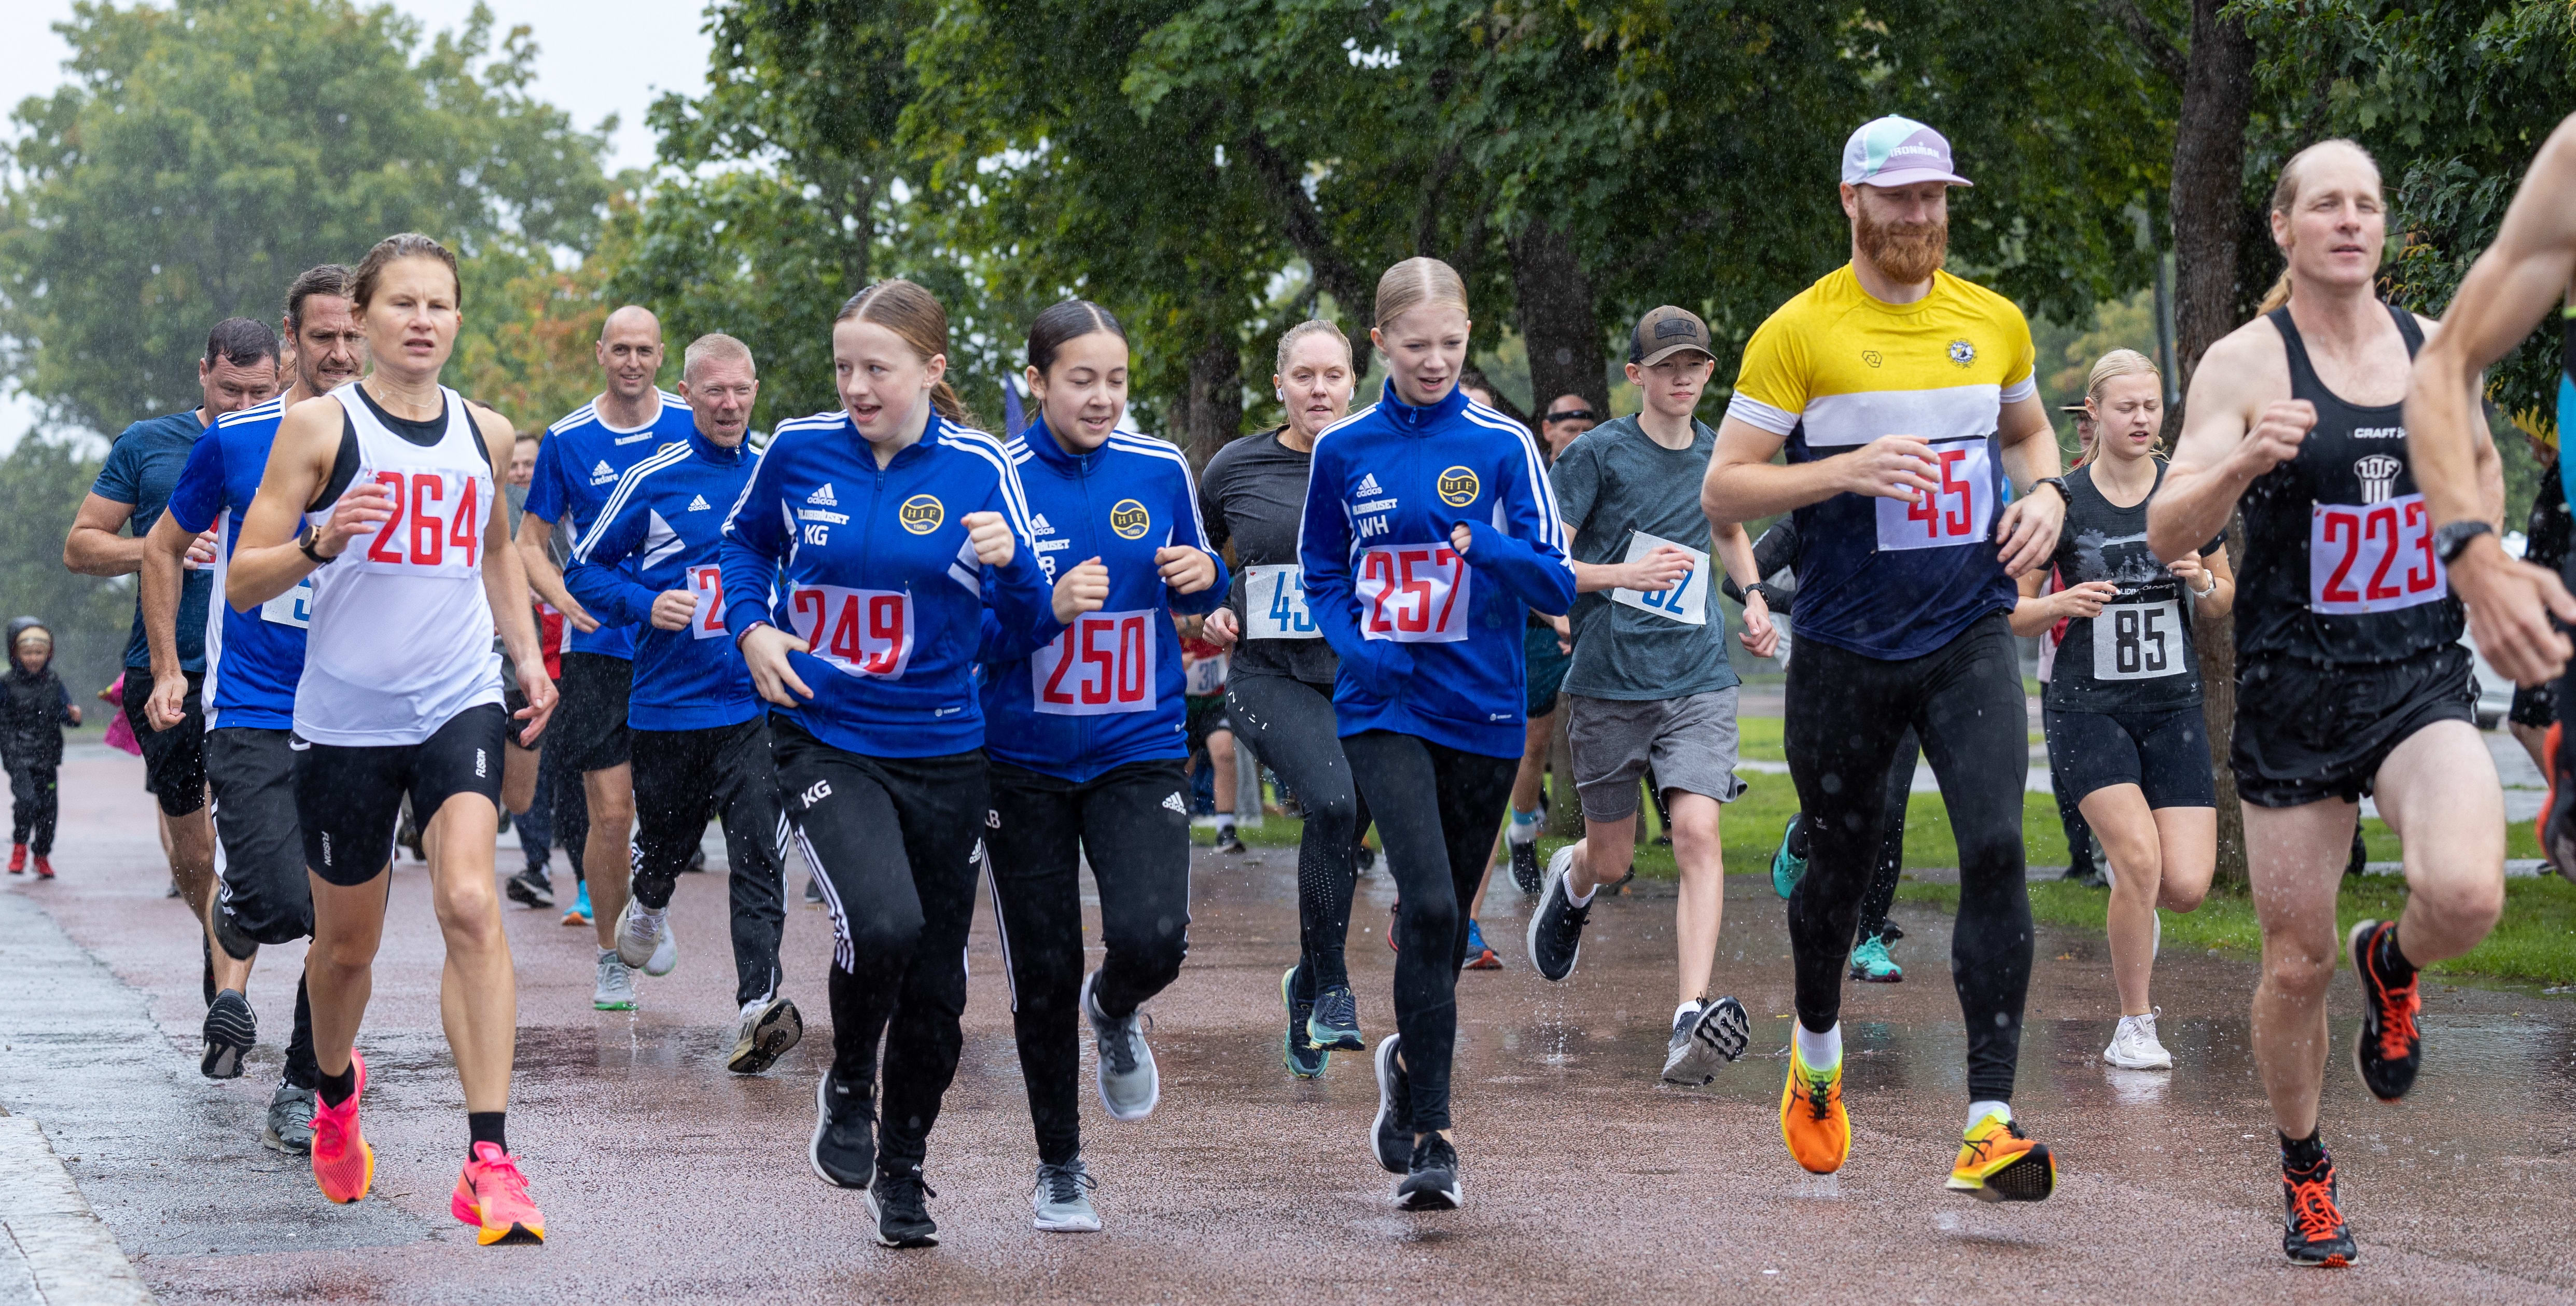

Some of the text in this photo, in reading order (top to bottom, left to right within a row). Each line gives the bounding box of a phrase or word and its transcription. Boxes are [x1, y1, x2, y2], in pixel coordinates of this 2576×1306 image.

[1889, 142, 1940, 159] IRONMAN
[2354, 427, 2397, 439] CRAFT
[590, 473, 619, 486] Ledare
[1445, 481, 1472, 490] HIF
[807, 496, 838, 507] adidas
[1356, 487, 1383, 498] adidas
[1908, 449, 1972, 538] 45
[368, 471, 477, 567] 264
[688, 504, 711, 512] adidas
[908, 509, 937, 518] HIF
[1118, 513, 1143, 525] HIF
[804, 524, 829, 546] KG
[1358, 515, 1389, 538] WH
[2322, 500, 2436, 603] 223
[1041, 556, 1056, 575] B
[1366, 548, 1464, 633] 257
[795, 590, 903, 674] 249
[2115, 608, 2167, 673] 85
[1043, 616, 1146, 704] 250
[476, 748, 486, 778] FUSION
[801, 780, 832, 809] KG
[322, 831, 331, 866] FUSION
